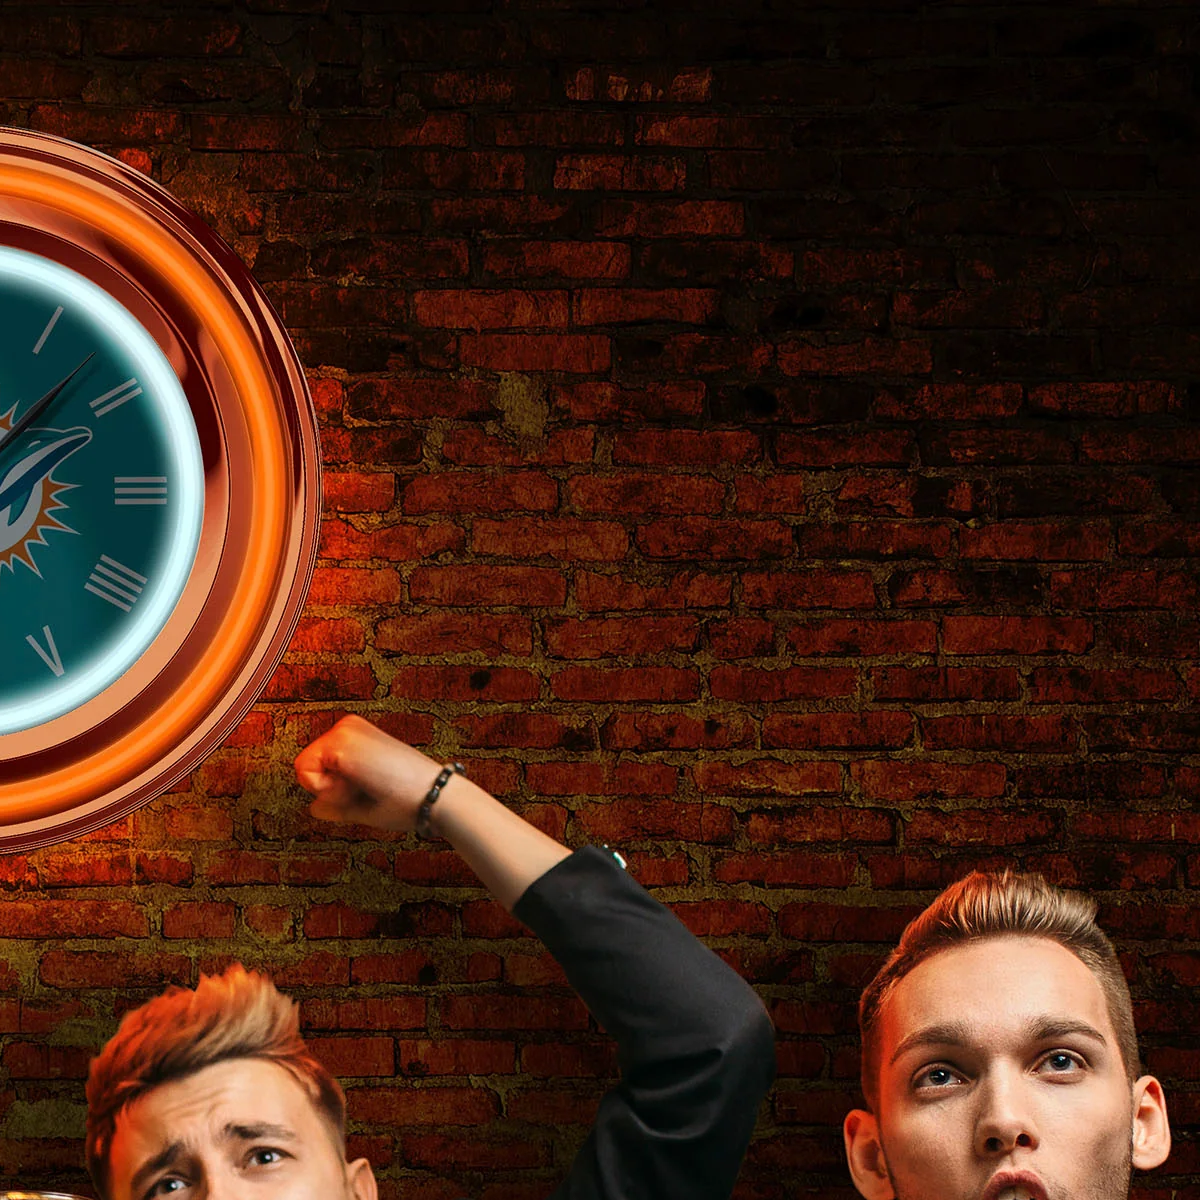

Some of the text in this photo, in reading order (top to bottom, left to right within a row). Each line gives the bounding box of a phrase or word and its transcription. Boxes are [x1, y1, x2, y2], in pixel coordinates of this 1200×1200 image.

[89, 377, 143, 418] II
[114, 476, 168, 505] III
[84, 554, 148, 614] IIII
[25, 624, 65, 677] V
